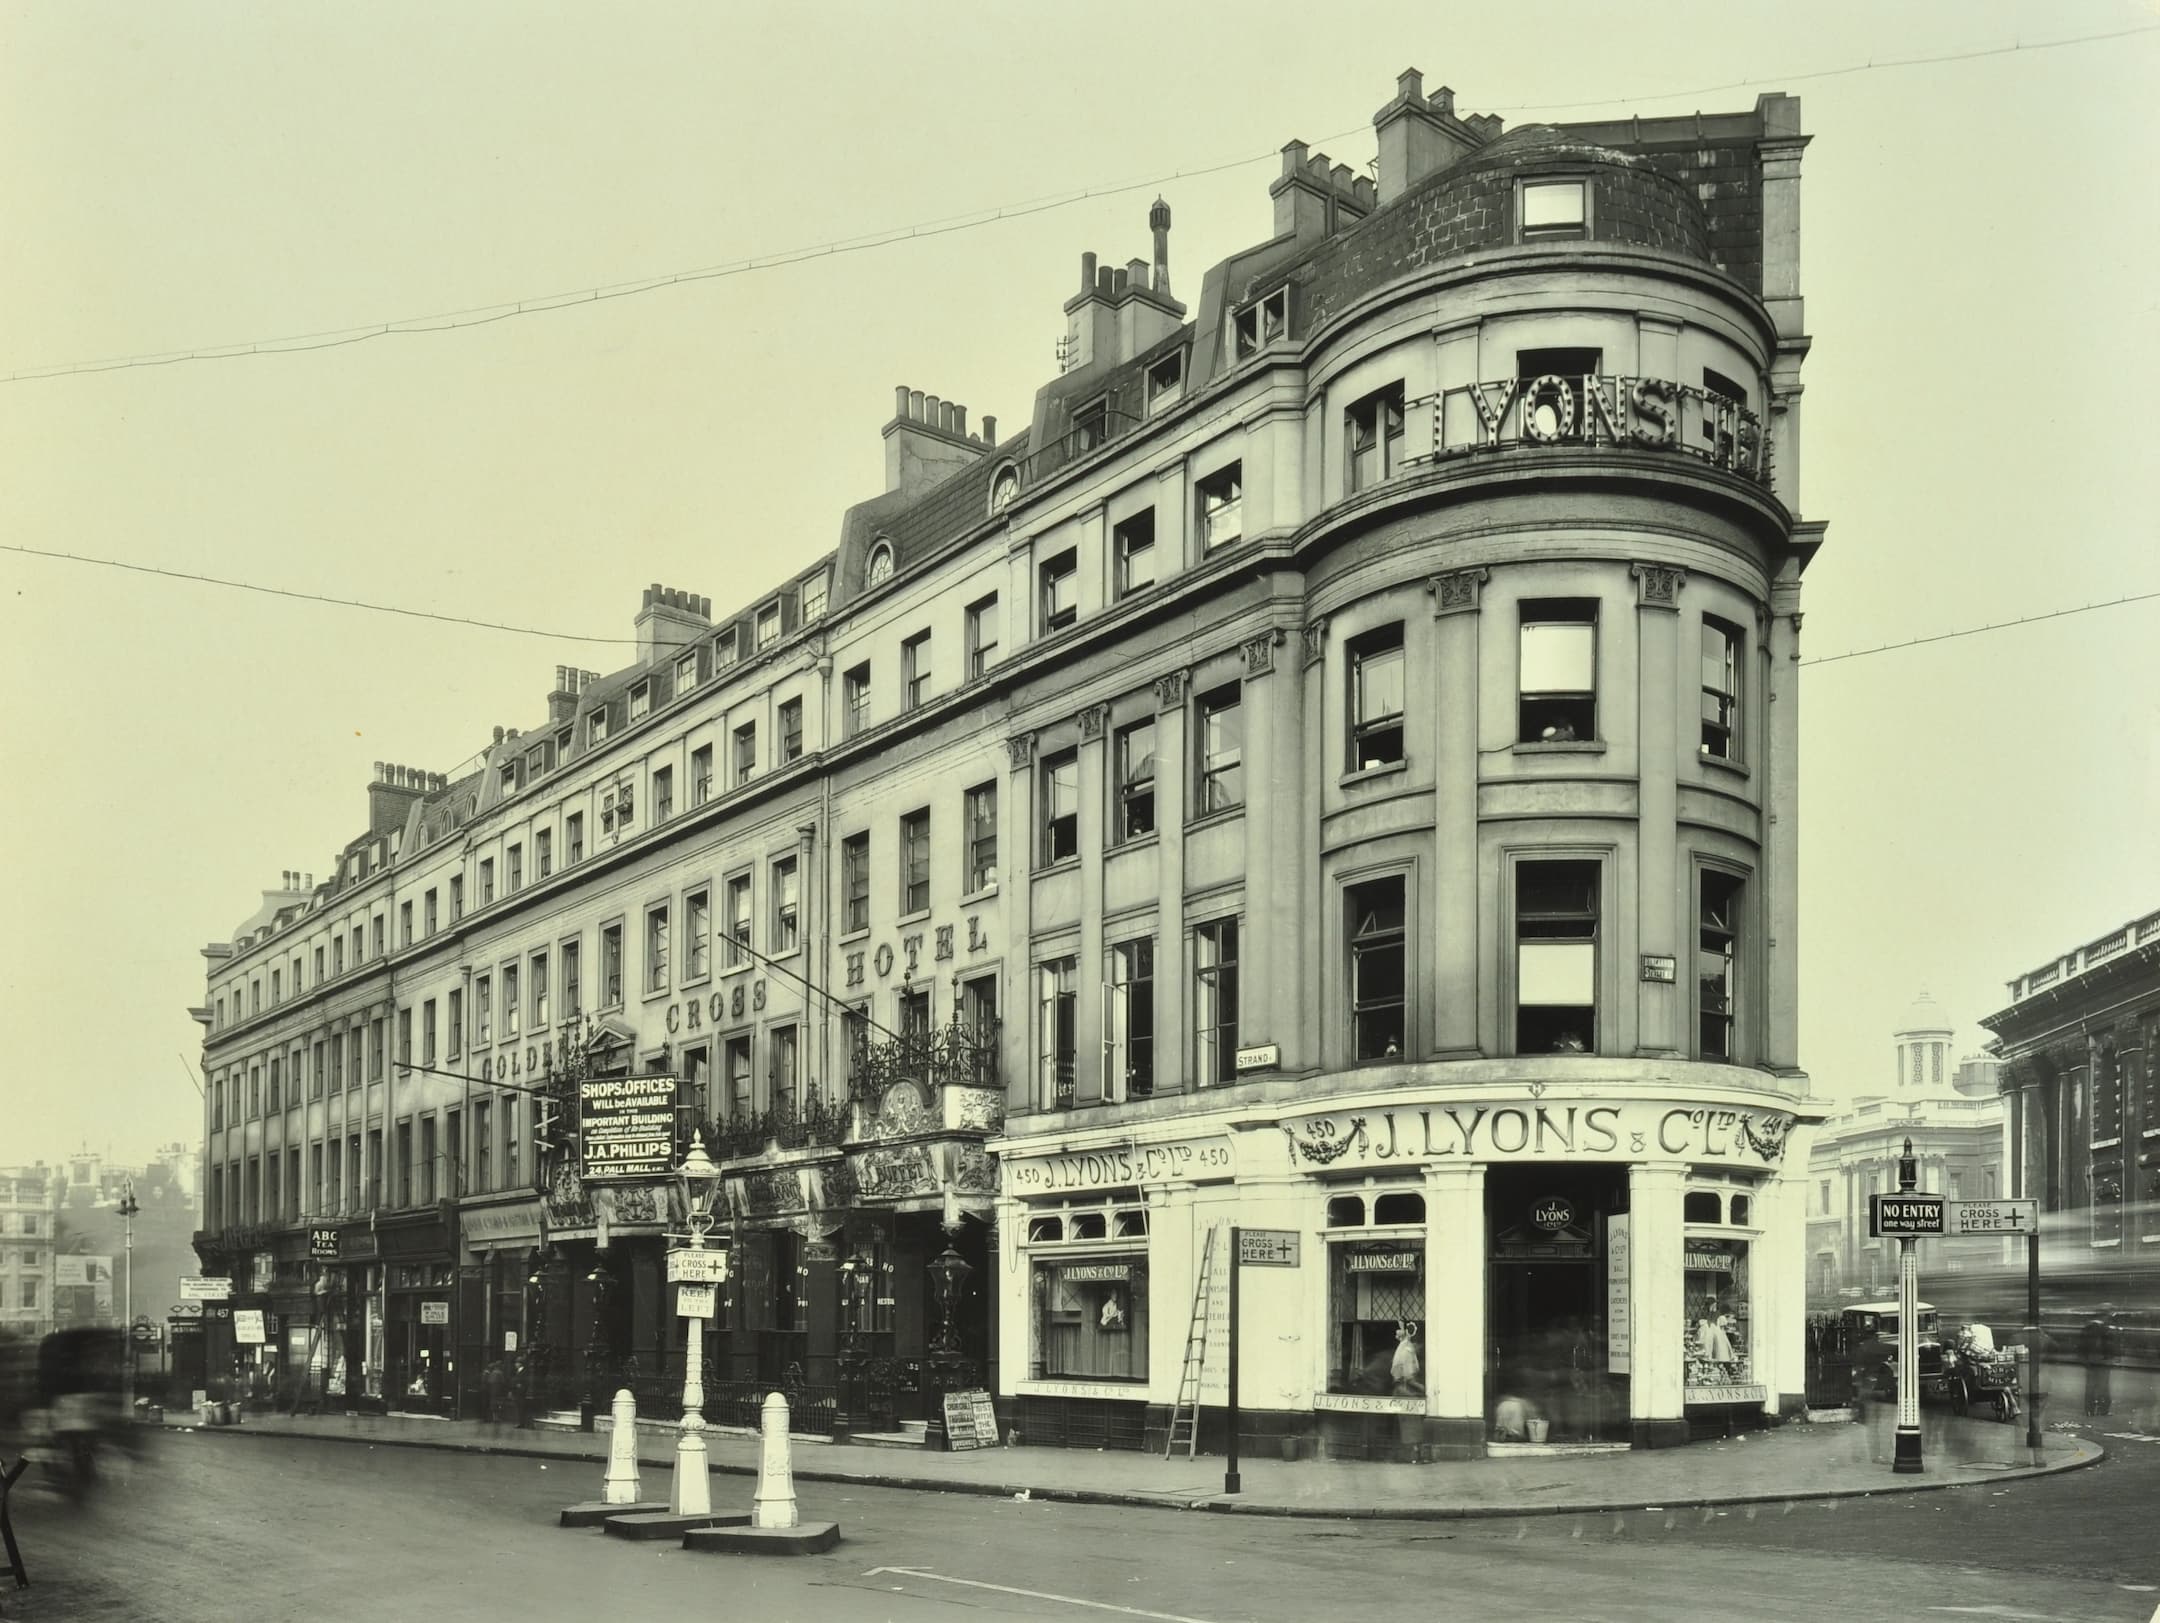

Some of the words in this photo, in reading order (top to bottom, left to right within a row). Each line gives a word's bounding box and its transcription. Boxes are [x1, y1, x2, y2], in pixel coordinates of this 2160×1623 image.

[845, 915, 987, 988] HOTEL
[665, 978, 767, 1034] CROSS
[481, 1031, 569, 1081] GOLDEN
[1238, 1053, 1269, 1067] STRAND
[582, 1083, 622, 1098] SHOPS
[624, 1078, 675, 1096] OFFICES
[592, 1099, 613, 1110] WILL
[625, 1095, 668, 1108] AVAILABLE
[582, 1116, 630, 1128] IMPORTANT
[631, 1113, 674, 1125] BUILDING
[1306, 1117, 1336, 1140] 450
[1630, 1131, 1647, 1154] &
[603, 1165, 625, 1174] PALL
[876, 1161, 925, 1183] BUFFET
[1016, 1167, 1040, 1185] 450
[1199, 1147, 1230, 1168] 450
[1535, 1208, 1570, 1222] LYONS
[1883, 1204, 1900, 1218] NO
[1902, 1204, 1941, 1218] ENTRY
[1960, 1208, 2000, 1218] CROSS
[1899, 1221, 1915, 1230] way
[1916, 1219, 1940, 1228] street
[1960, 1219, 2001, 1229] HERE
[317, 1241, 334, 1249] TEA
[1241, 1238, 1273, 1249] CROSS
[1241, 1249, 1274, 1260] HERE
[681, 1259, 707, 1269] CROSS
[682, 1269, 706, 1278] HERE
[681, 1288, 711, 1298] KEEP
